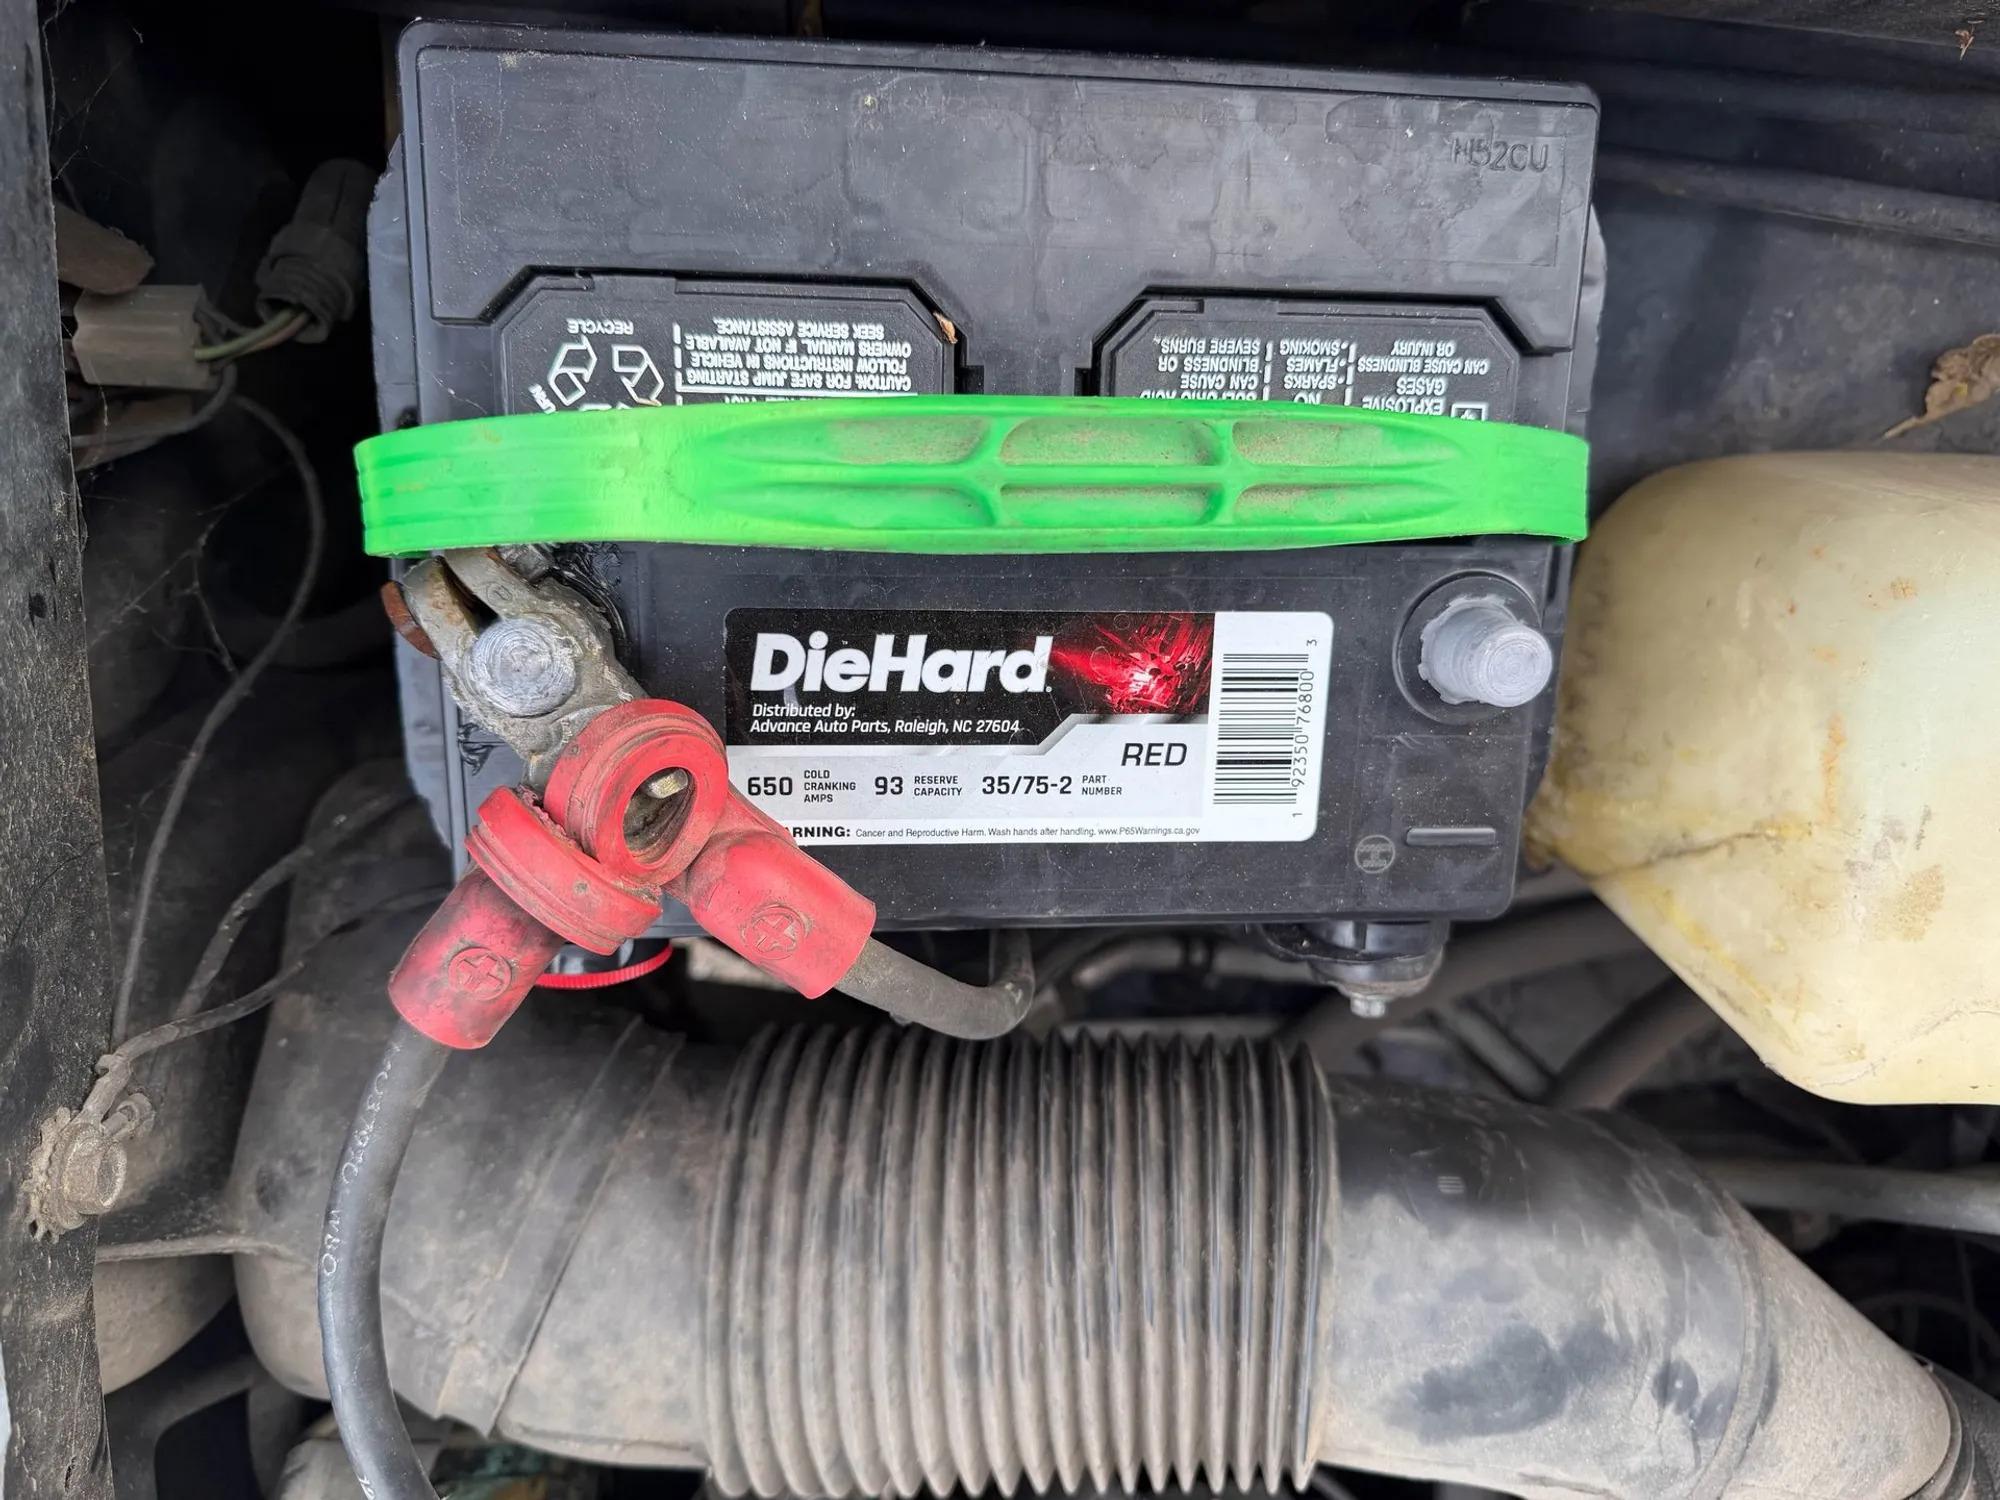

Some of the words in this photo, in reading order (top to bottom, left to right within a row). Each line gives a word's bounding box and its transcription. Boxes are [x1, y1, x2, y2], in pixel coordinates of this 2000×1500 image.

[566, 318, 634, 335] RECYCLE
[713, 318, 794, 336] ASSISTANCE.
[797, 321, 849, 339] SERVICE
[853, 323, 884, 340] SEEK
[684, 334, 751, 351] AVAILABLE
[755, 336, 781, 353] NOT
[786, 338, 797, 353] IF
[859, 341, 912, 357] OWNERS
[1210, 338, 1261, 355] SEVERE
[1280, 338, 1341, 356] SMOKING
[1391, 339, 1435, 356] INJURY
[1436, 341, 1455, 357] OR
[690, 351, 742, 368] VEHICLE
[747, 353, 760, 369] IN
[764, 354, 853, 372] INSTRUCTIONS
[857, 357, 907, 374] FOLLOW
[1158, 355, 1178, 372] OR
[1184, 355, 1259, 372] BLINDNESS
[1287, 356, 1339, 372] FLAMES
[1357, 355, 1422, 372] BLINDNESS
[1423, 357, 1463, 374] CAUSE
[1464, 358, 1488, 375] CAN
[687, 369, 749, 385] STARTING
[753, 370, 787, 387] JUMP
[791, 372, 822, 388] SAFE
[826, 373, 852, 389] FOR
[855, 374, 911, 391] CAUTION:
[1180, 373, 1226, 389] CAUSE
[1230, 373, 1259, 389] CAN
[1284, 373, 1337, 390] SPARKS
[1396, 374, 1446, 395] GASES
[1294, 390, 1322, 405] NO
[1362, 395, 1445, 415] EXPLOSIVE
[1306, 639, 1317, 647] 3
[750, 631, 1053, 693] DieHard
[1296, 671, 1314, 725] 76800
[753, 704, 832, 717] Distributed
[835, 704, 856, 719] by:
[750, 720, 811, 733] Advance
[814, 720, 848, 733] Auto
[852, 720, 891, 735] Parts,
[895, 720, 949, 735] Raleigh,
[953, 720, 971, 733] NC
[975, 720, 1019, 733] 27604
[1121, 743, 1187, 767] RED
[1291, 735, 1309, 787] 92350
[804, 770, 829, 779] COLD
[914, 776, 958, 784] RESERVE
[1081, 775, 1106, 783] PART
[748, 777, 792, 796] 650
[804, 782, 856, 791] CRANKING
[875, 776, 903, 795] 93
[914, 788, 962, 796] CAPACITY
[982, 776, 1072, 795] 35/75-2
[1081, 787, 1122, 795] NUMBER
[804, 794, 833, 803] AMPS
[785, 827, 850, 838] RNING:
[855, 829, 886, 838] Cancer
[887, 828, 903, 838] and
[906, 828, 959, 839] Reproductive
[989, 828, 1011, 837] Wash
[1013, 828, 1038, 836] hands
[1040, 828, 1058, 836] after
[1098, 827, 1200, 837] www.P65Warnings.ca.gov
